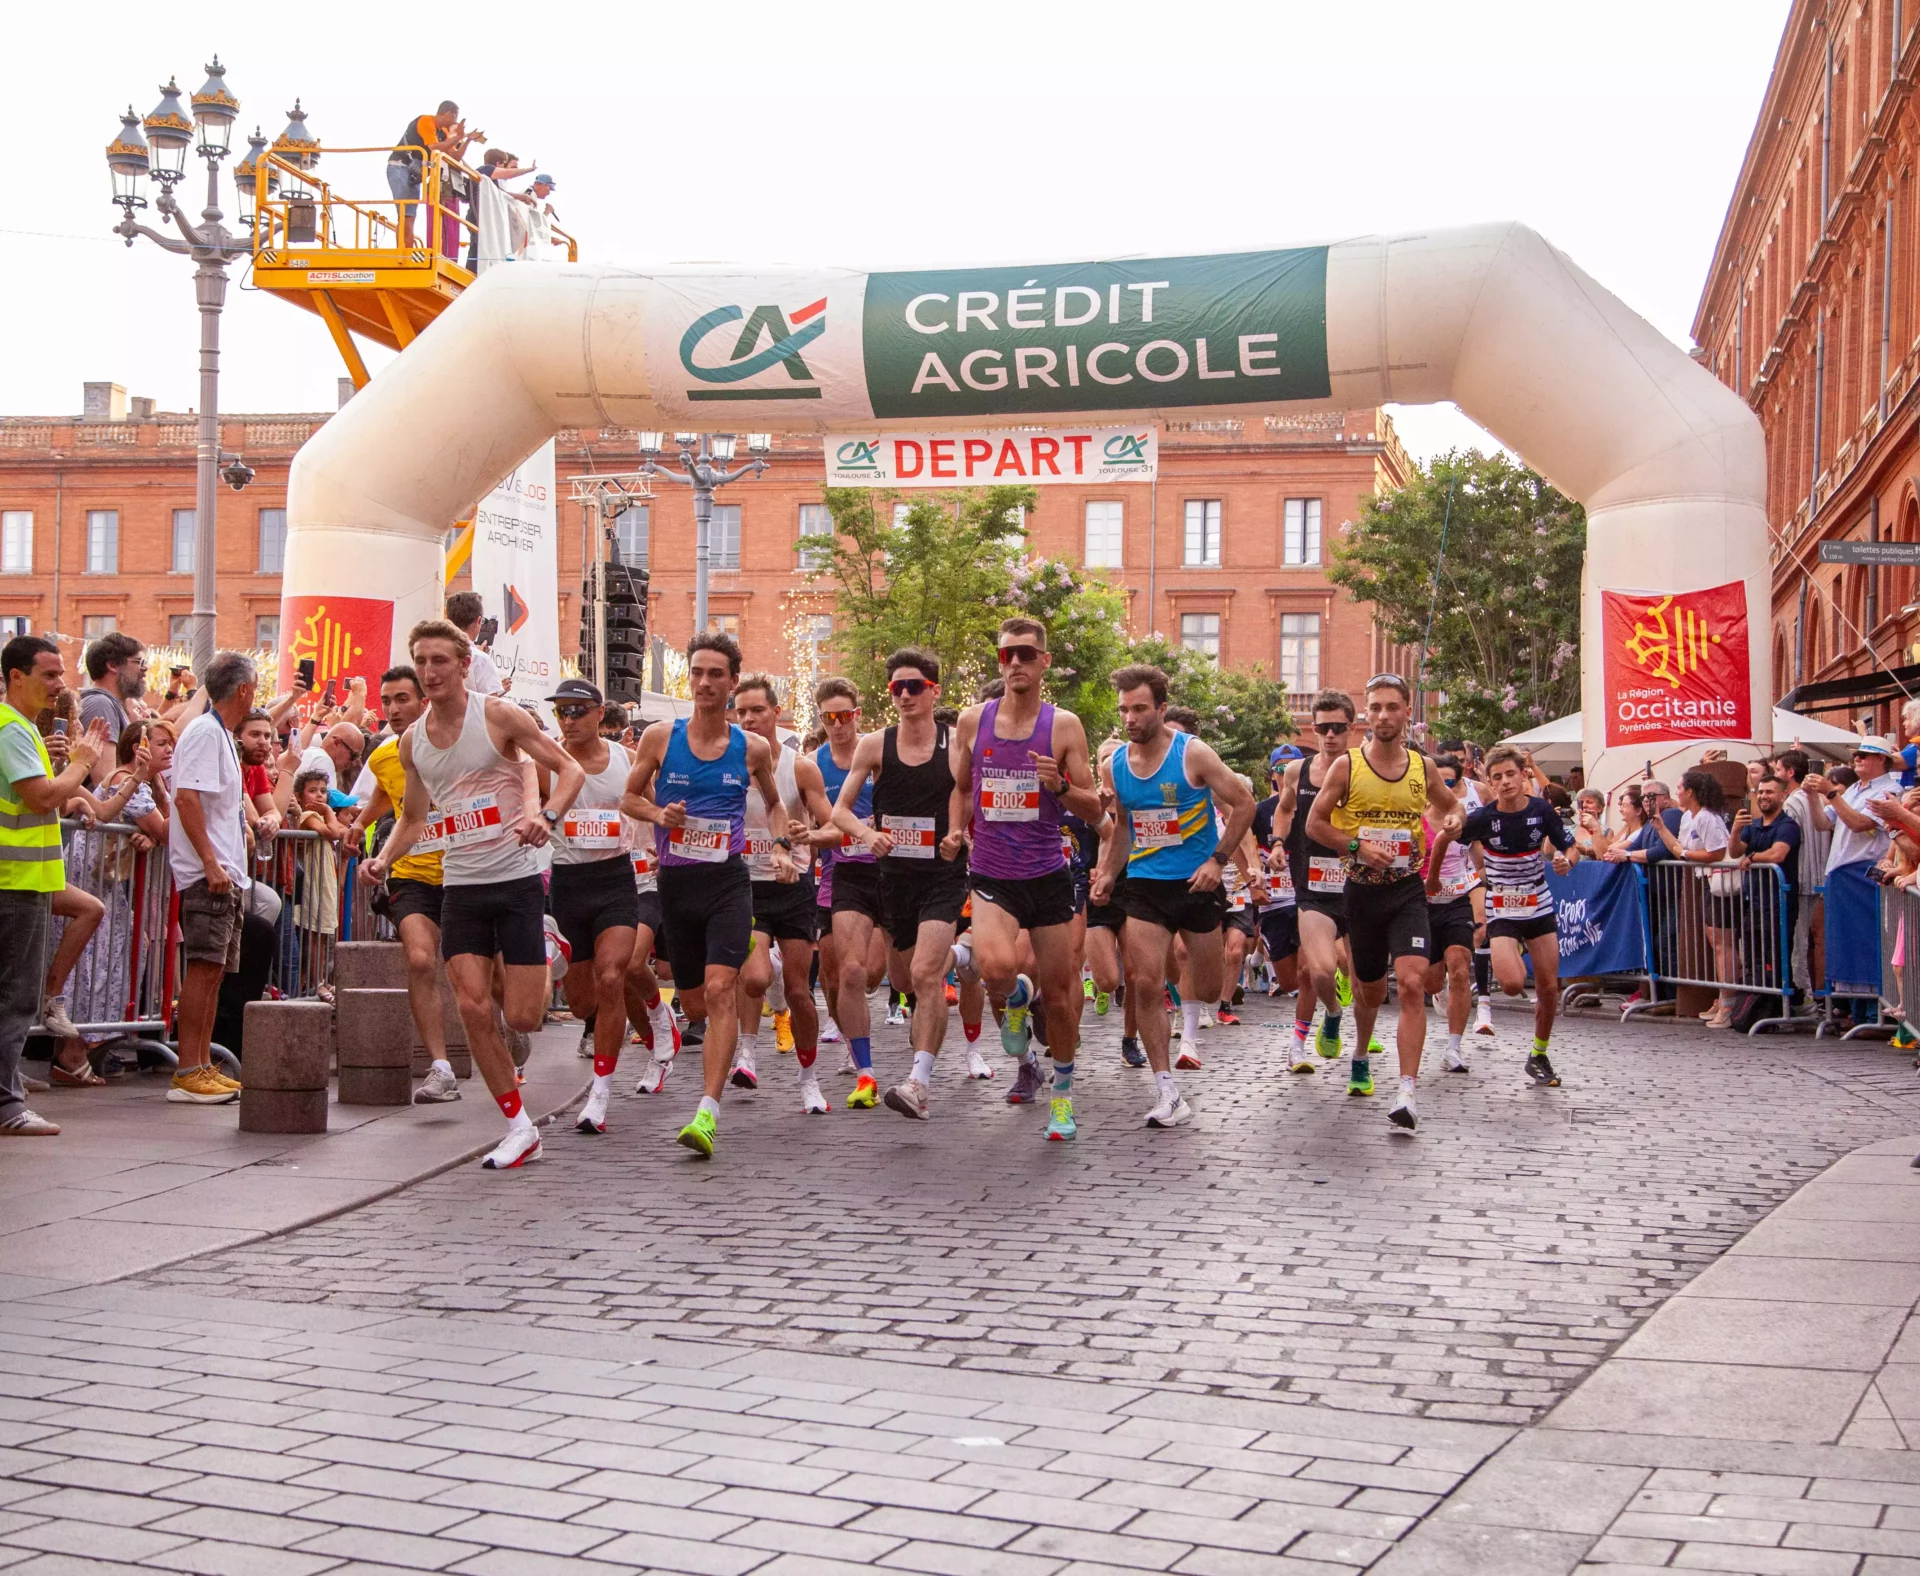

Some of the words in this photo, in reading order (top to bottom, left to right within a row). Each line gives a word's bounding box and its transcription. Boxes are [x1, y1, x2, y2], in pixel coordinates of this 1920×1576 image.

[905, 279, 1170, 335] CRÉDIT
[910, 332, 1282, 395] AGRICOLE
[893, 435, 1093, 478] DEPART
[874, 470, 887, 479] 31
[1098, 466, 1139, 474] TOULOUSE
[1141, 464, 1154, 473] 31
[487, 530, 534, 553] ARCHIVER
[1852, 546, 1880, 554] toilettes
[1881, 547, 1914, 556] publiques
[1617, 691, 1627, 700] La
[1629, 688, 1664, 699] Région
[1618, 696, 1736, 721] Occitanie
[1619, 722, 1662, 734] Pyrénées
[1670, 718, 1737, 729] Méditerranée
[477, 796, 491, 805] EAU
[992, 792, 1027, 808] 6002
[453, 810, 486, 832] 6001
[1355, 810, 1380, 819] CHEZ
[417, 825, 438, 842] 03
[576, 822, 608, 836] 6006
[890, 829, 922, 845] 6999
[1141, 821, 1168, 837] 6382
[682, 829, 717, 848] 6860
[750, 840, 773, 854] 600
[1279, 876, 1292, 888] 65
[1435, 884, 1457, 896] 982
[1502, 895, 1529, 908] 6627
